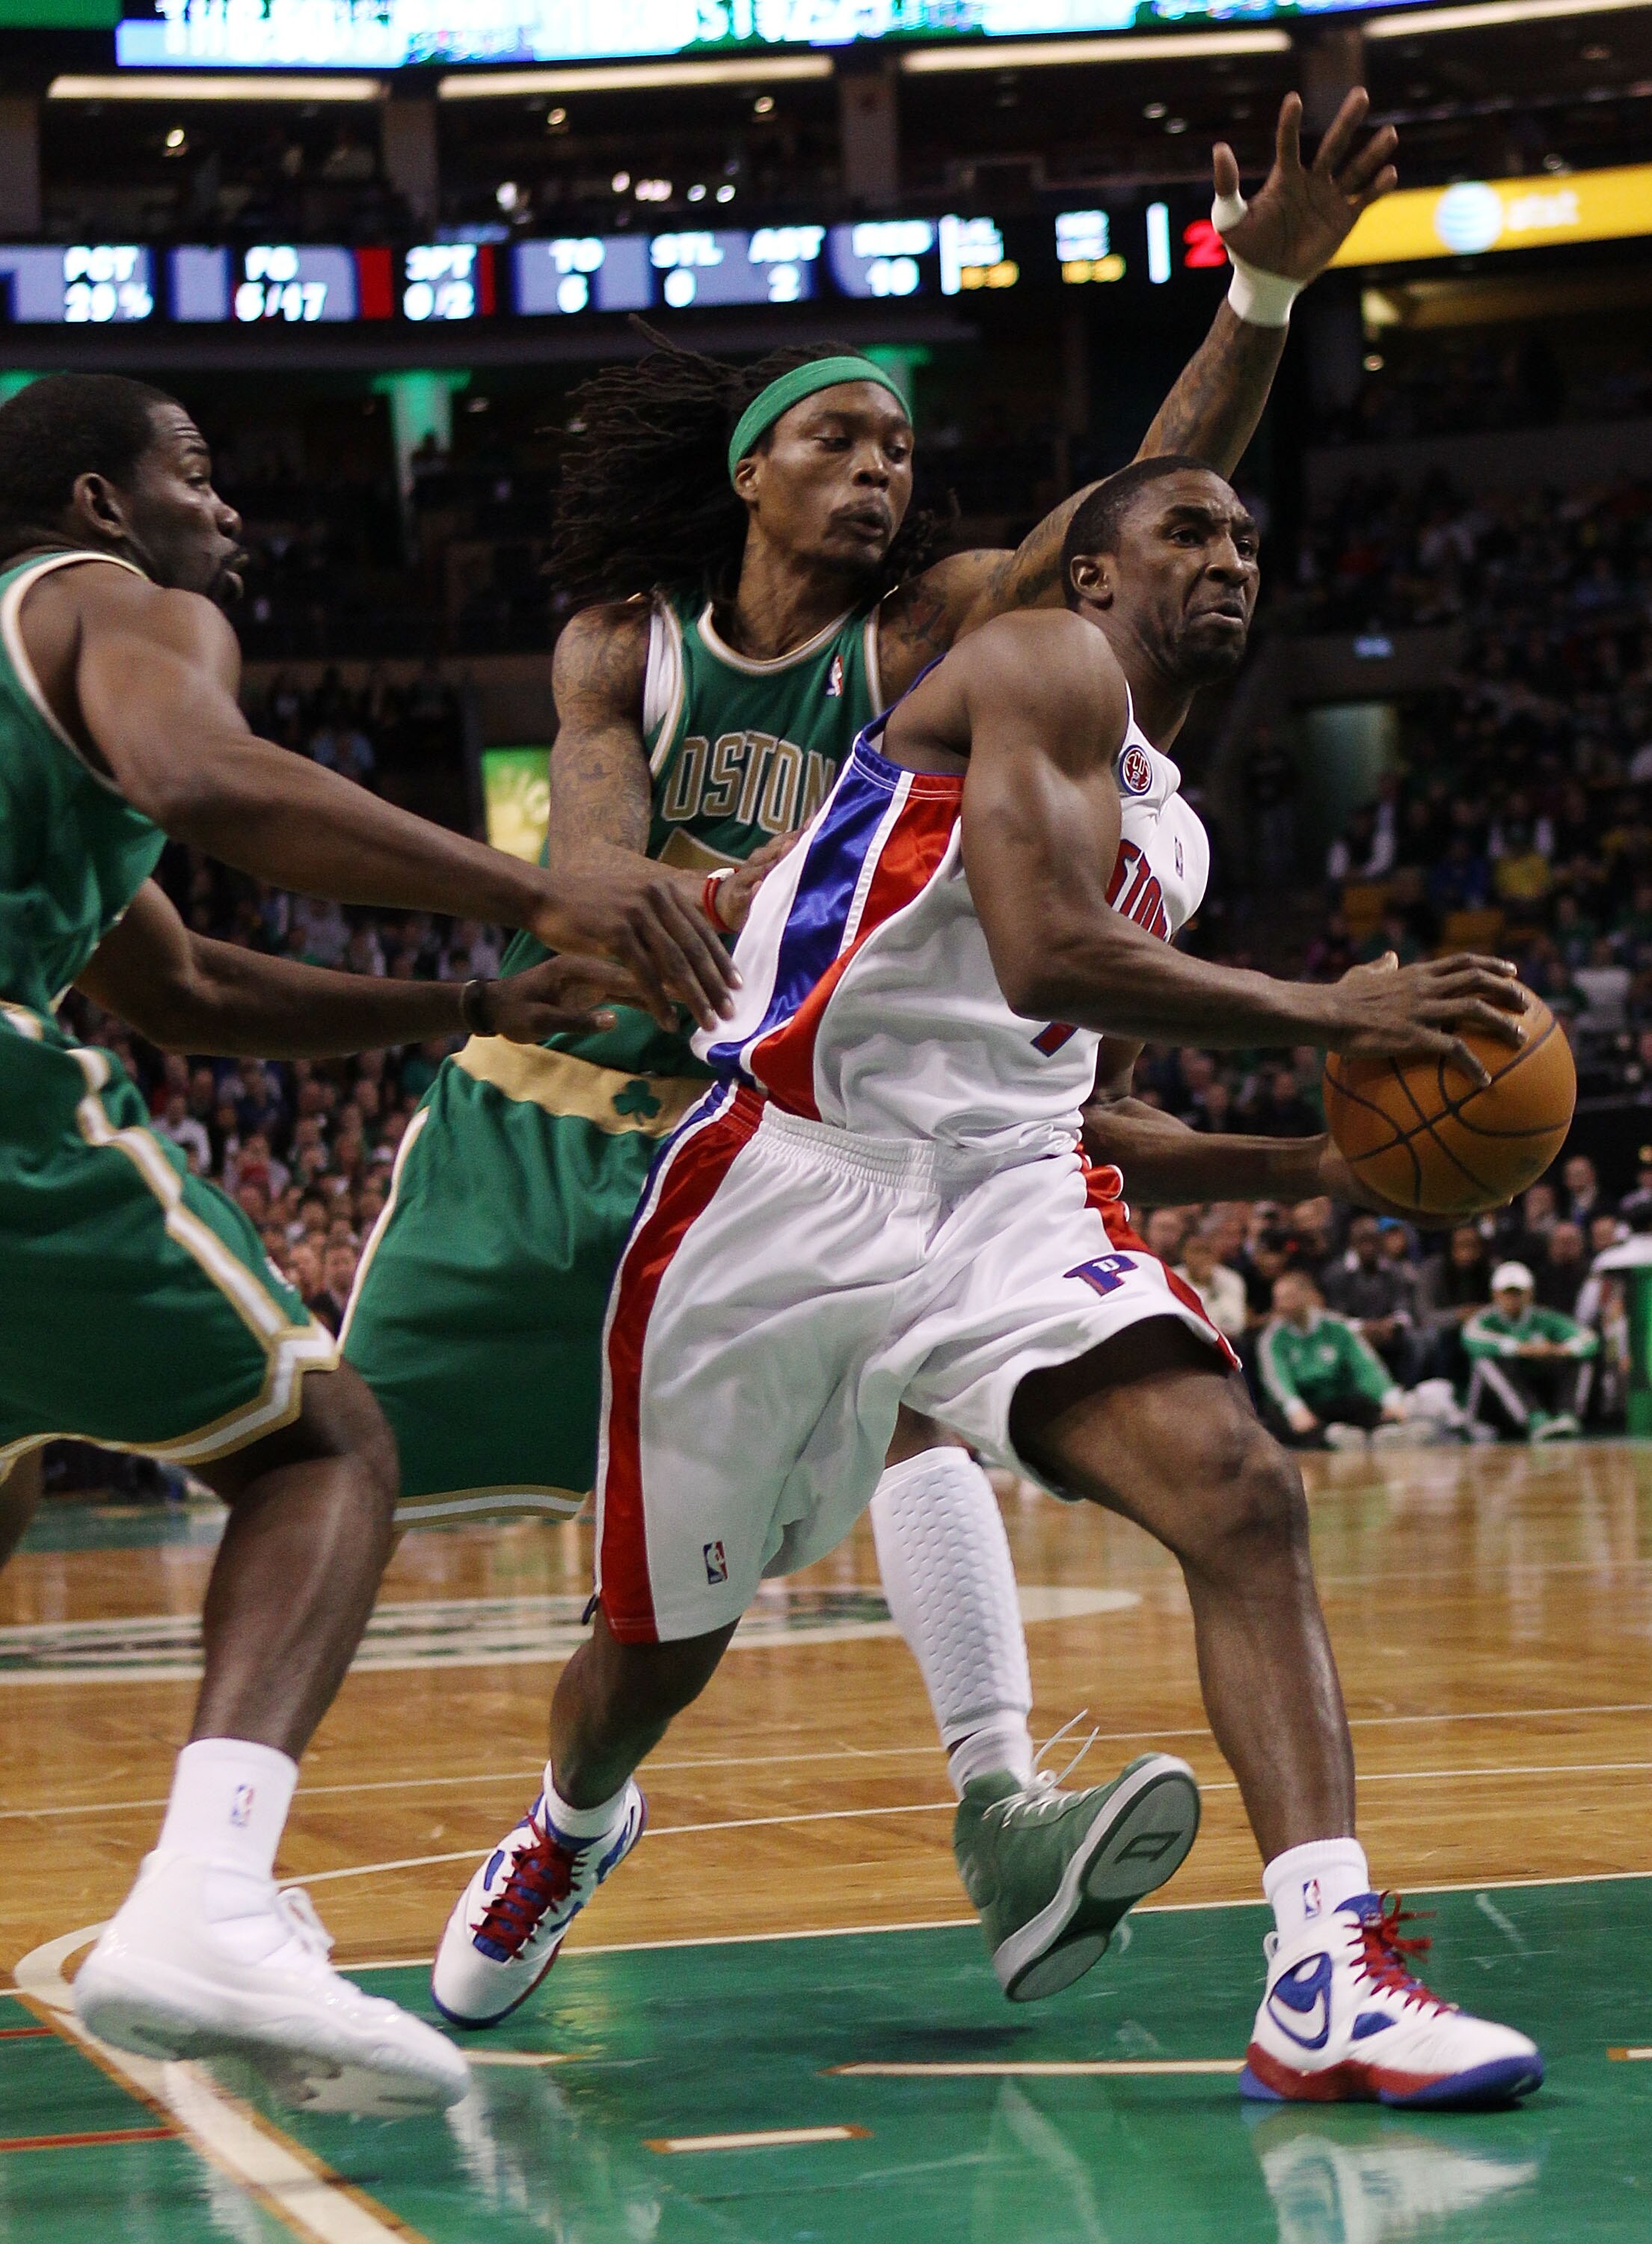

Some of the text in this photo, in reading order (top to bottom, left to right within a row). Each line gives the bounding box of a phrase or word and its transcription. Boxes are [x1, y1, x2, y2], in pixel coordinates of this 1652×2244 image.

[64, 247, 138, 281] PCT
[768, 264, 799, 301] 2
[661, 730, 837, 835] OSTON
